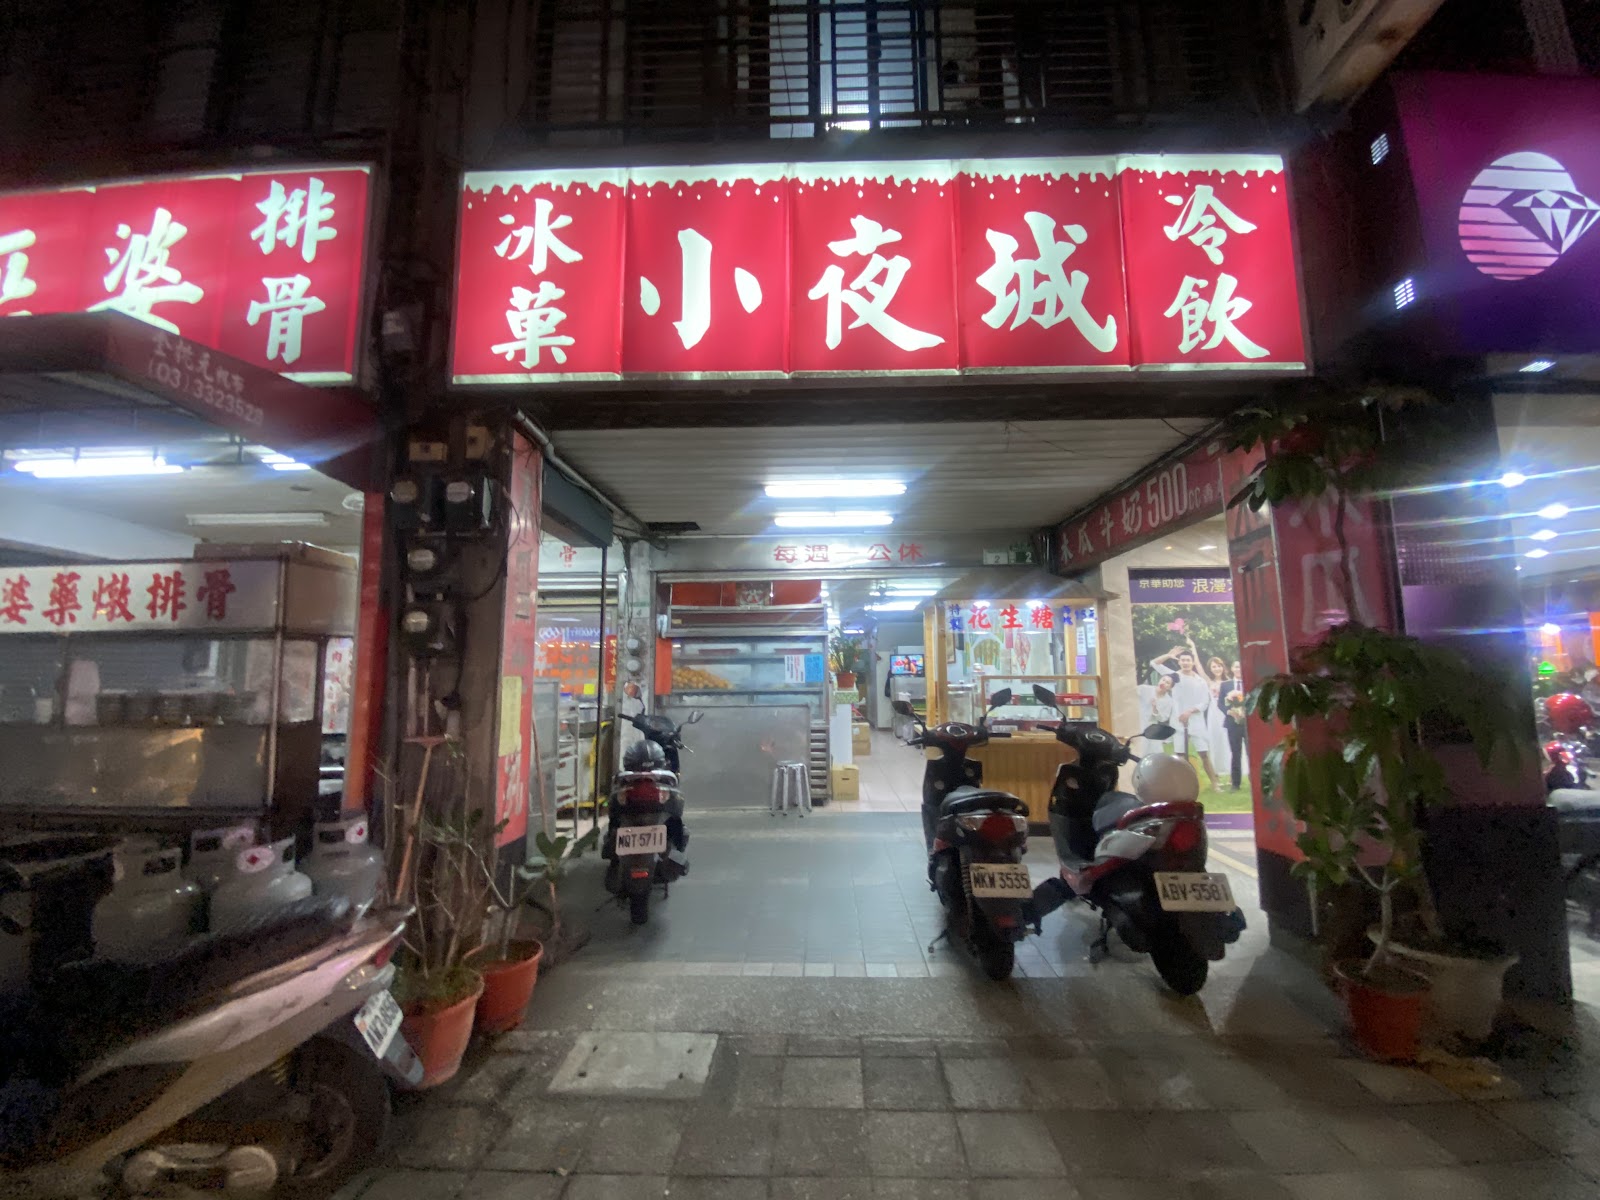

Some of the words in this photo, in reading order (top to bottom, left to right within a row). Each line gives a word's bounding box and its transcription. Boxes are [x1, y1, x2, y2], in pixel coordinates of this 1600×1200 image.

[247, 177, 338, 364] 排骨
[491, 198, 583, 369] 冰菓
[640, 211, 1118, 352] 小夜城
[1163, 184, 1271, 359] 冷飲
[774, 543, 923, 563] 每週一公休
[967, 604, 1055, 630] 花生糖
[1139, 578, 1186, 589] 京華助您
